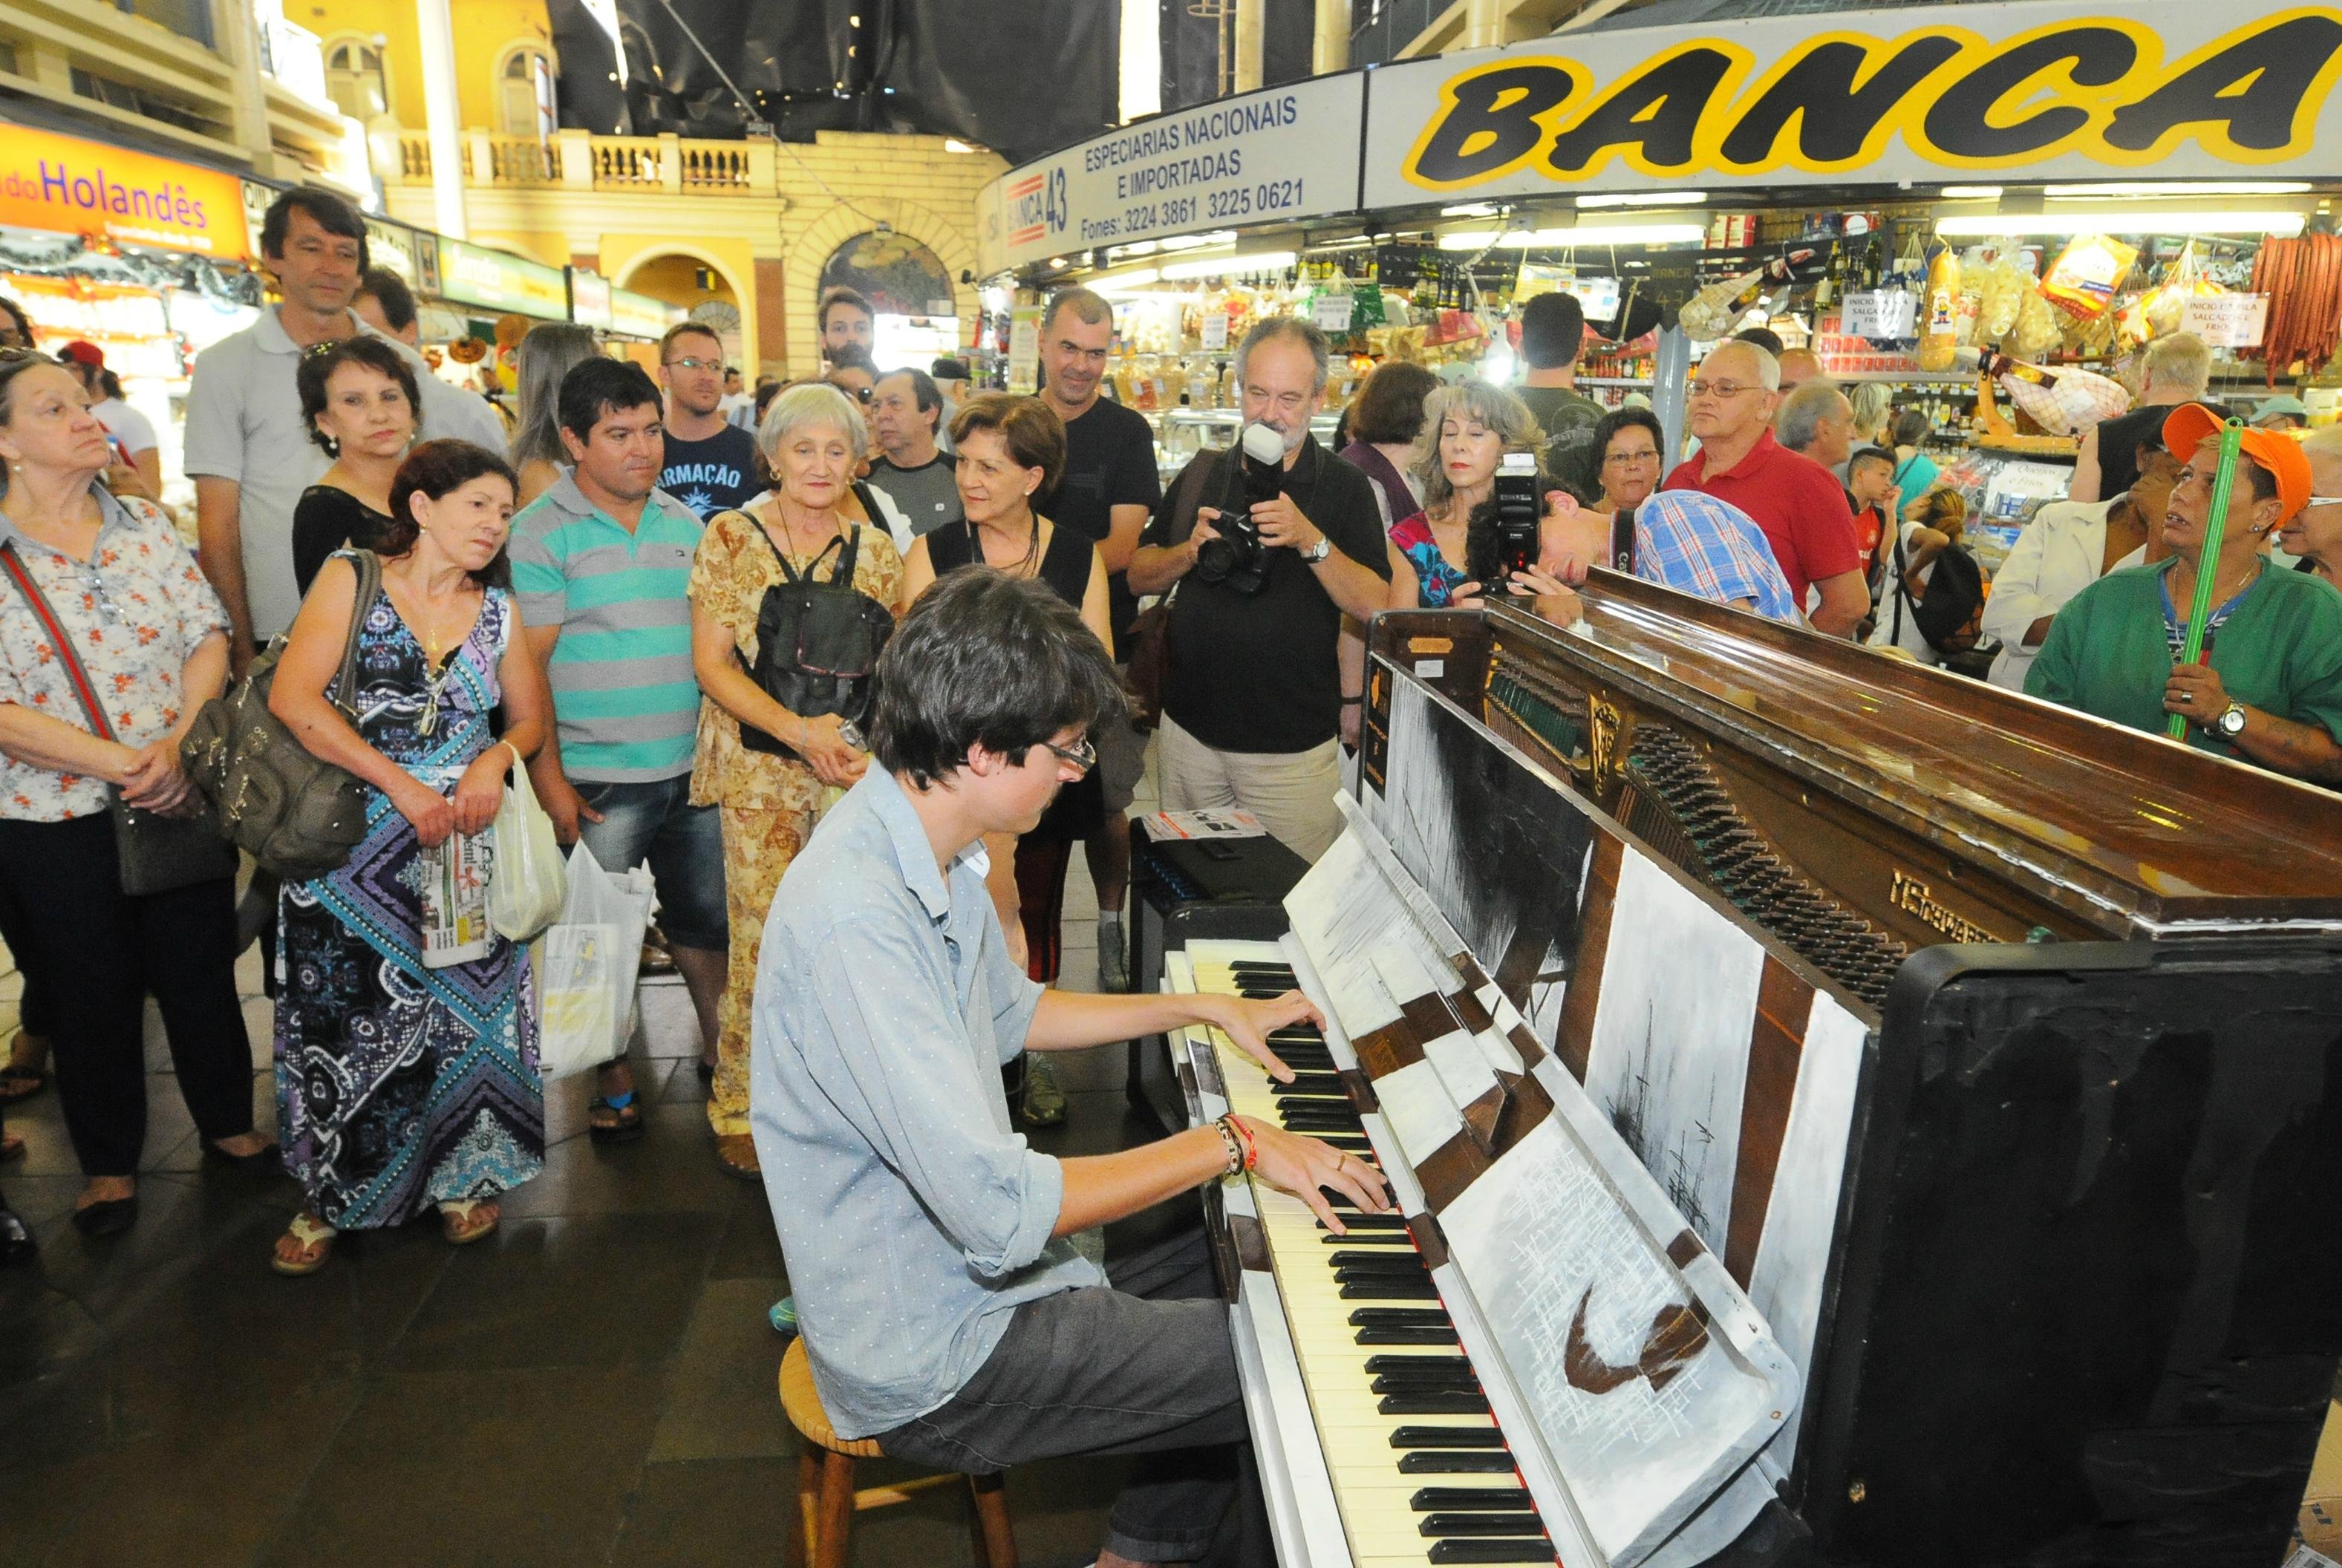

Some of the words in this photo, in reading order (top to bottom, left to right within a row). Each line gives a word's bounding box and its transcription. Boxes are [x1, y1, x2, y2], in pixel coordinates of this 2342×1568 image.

[1411, 10, 2342, 184] BANCA
[1086, 125, 1179, 172] ESPECIARIAS
[1184, 96, 1296, 147] NACIONAIS
[39, 160, 207, 229] Holandês
[1046, 166, 1066, 233] 43
[1118, 175, 1126, 199] E
[1131, 149, 1241, 197] IMPORTADAS
[1081, 217, 1121, 241] Fones:
[1125, 205, 1156, 232] 3224
[1161, 197, 1196, 226] 3861
[1208, 188, 1250, 218] 3225
[1256, 178, 1303, 211] 0621
[2190, 302, 2217, 310] INICIO
